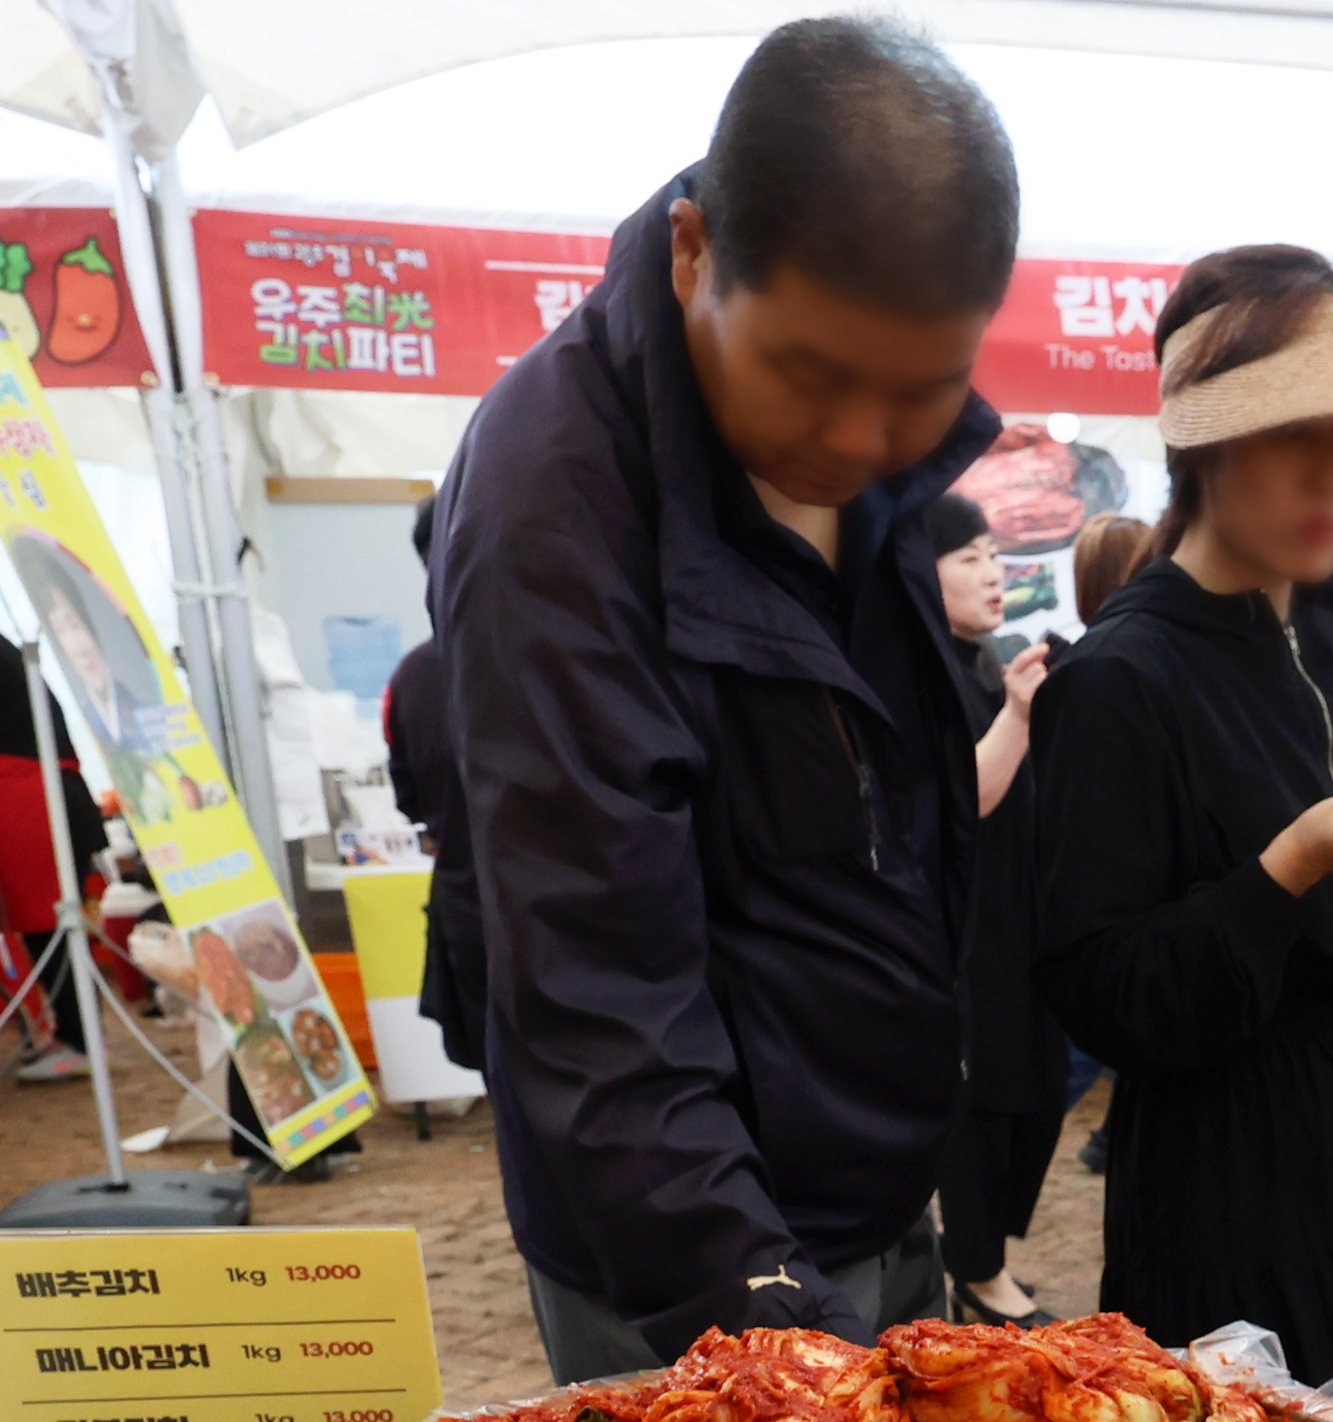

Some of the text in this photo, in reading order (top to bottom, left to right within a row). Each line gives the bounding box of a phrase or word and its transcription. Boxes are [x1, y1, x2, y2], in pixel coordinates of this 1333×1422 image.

[254, 320, 436, 377] 김치파티
[1043, 342, 1096, 371] The
[16, 1264, 362, 1298] 배추김치 1kg 13,000
[36, 1340, 374, 1374] 매니아김치 1kg 13,000
